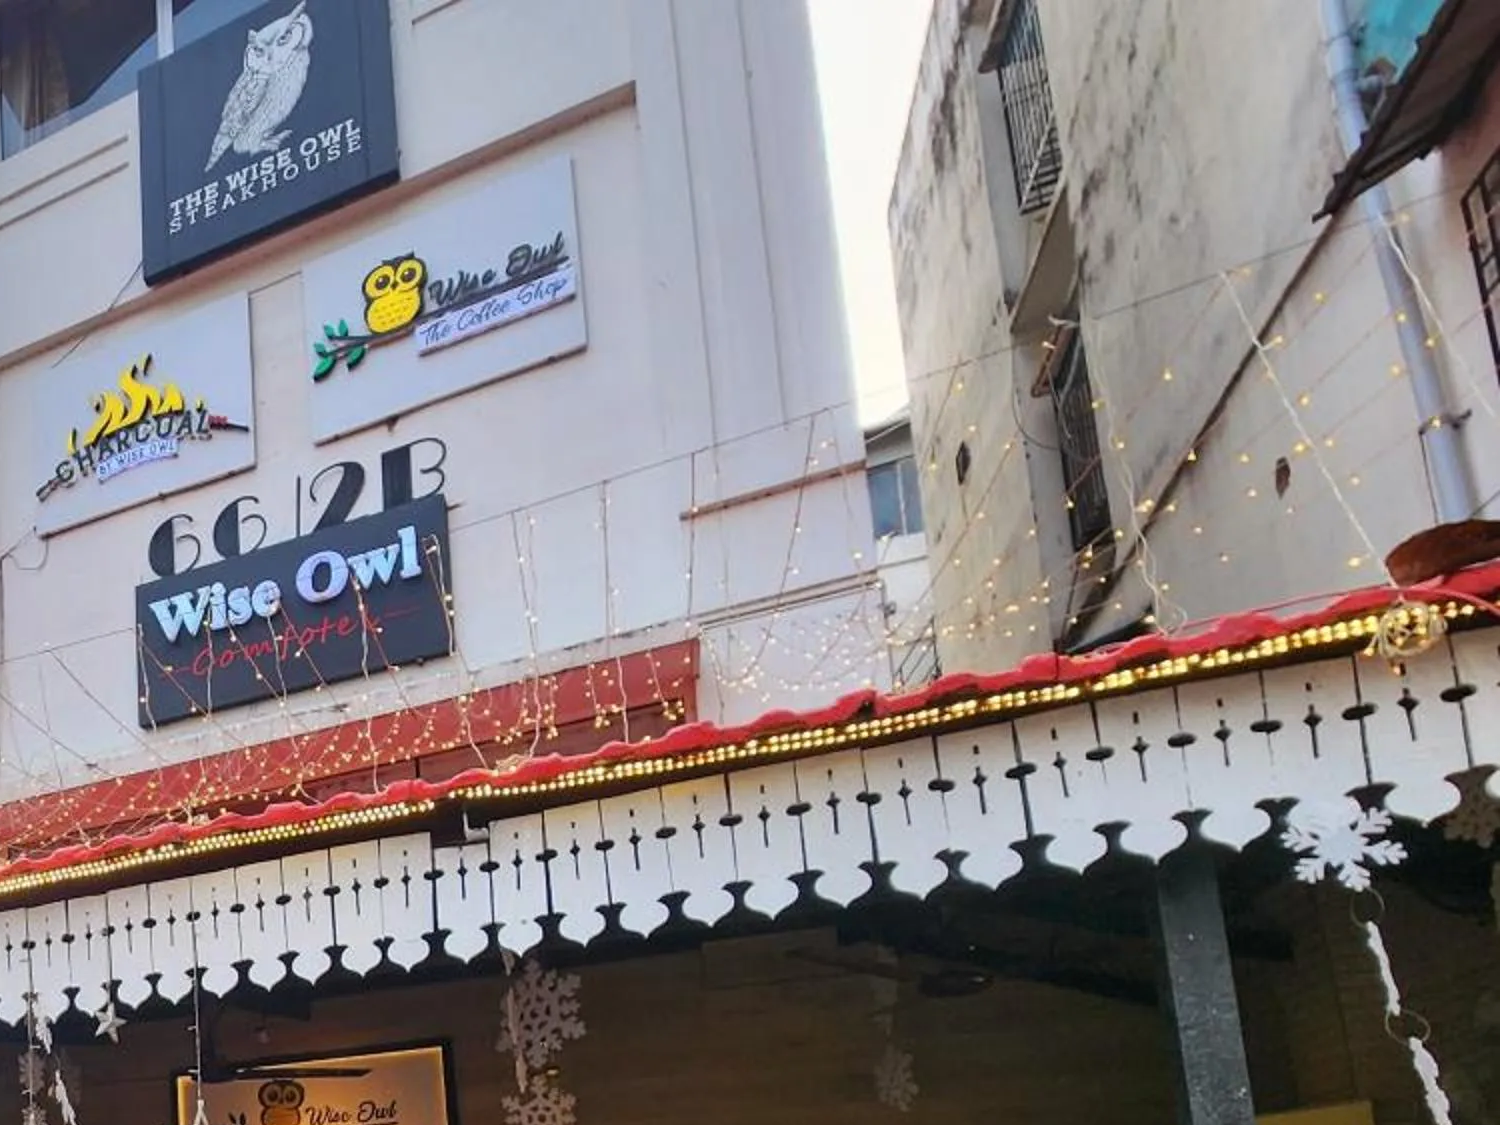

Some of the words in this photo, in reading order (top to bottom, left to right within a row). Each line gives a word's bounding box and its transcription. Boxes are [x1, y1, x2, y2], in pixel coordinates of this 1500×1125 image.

[168, 134, 362, 235] STEAKHOUSE
[169, 181, 220, 217] THE
[225, 148, 293, 192] WISE
[300, 118, 361, 157] OWL
[427, 268, 497, 307] Wise
[505, 230, 566, 277] Owl
[419, 319, 453, 346] The
[456, 298, 510, 331] Coffee
[516, 277, 568, 306] Shop
[150, 440, 177, 457] OWL
[148, 579, 282, 644] Wise
[295, 525, 423, 603] Owl
[356, 1099, 397, 1123] Owl
